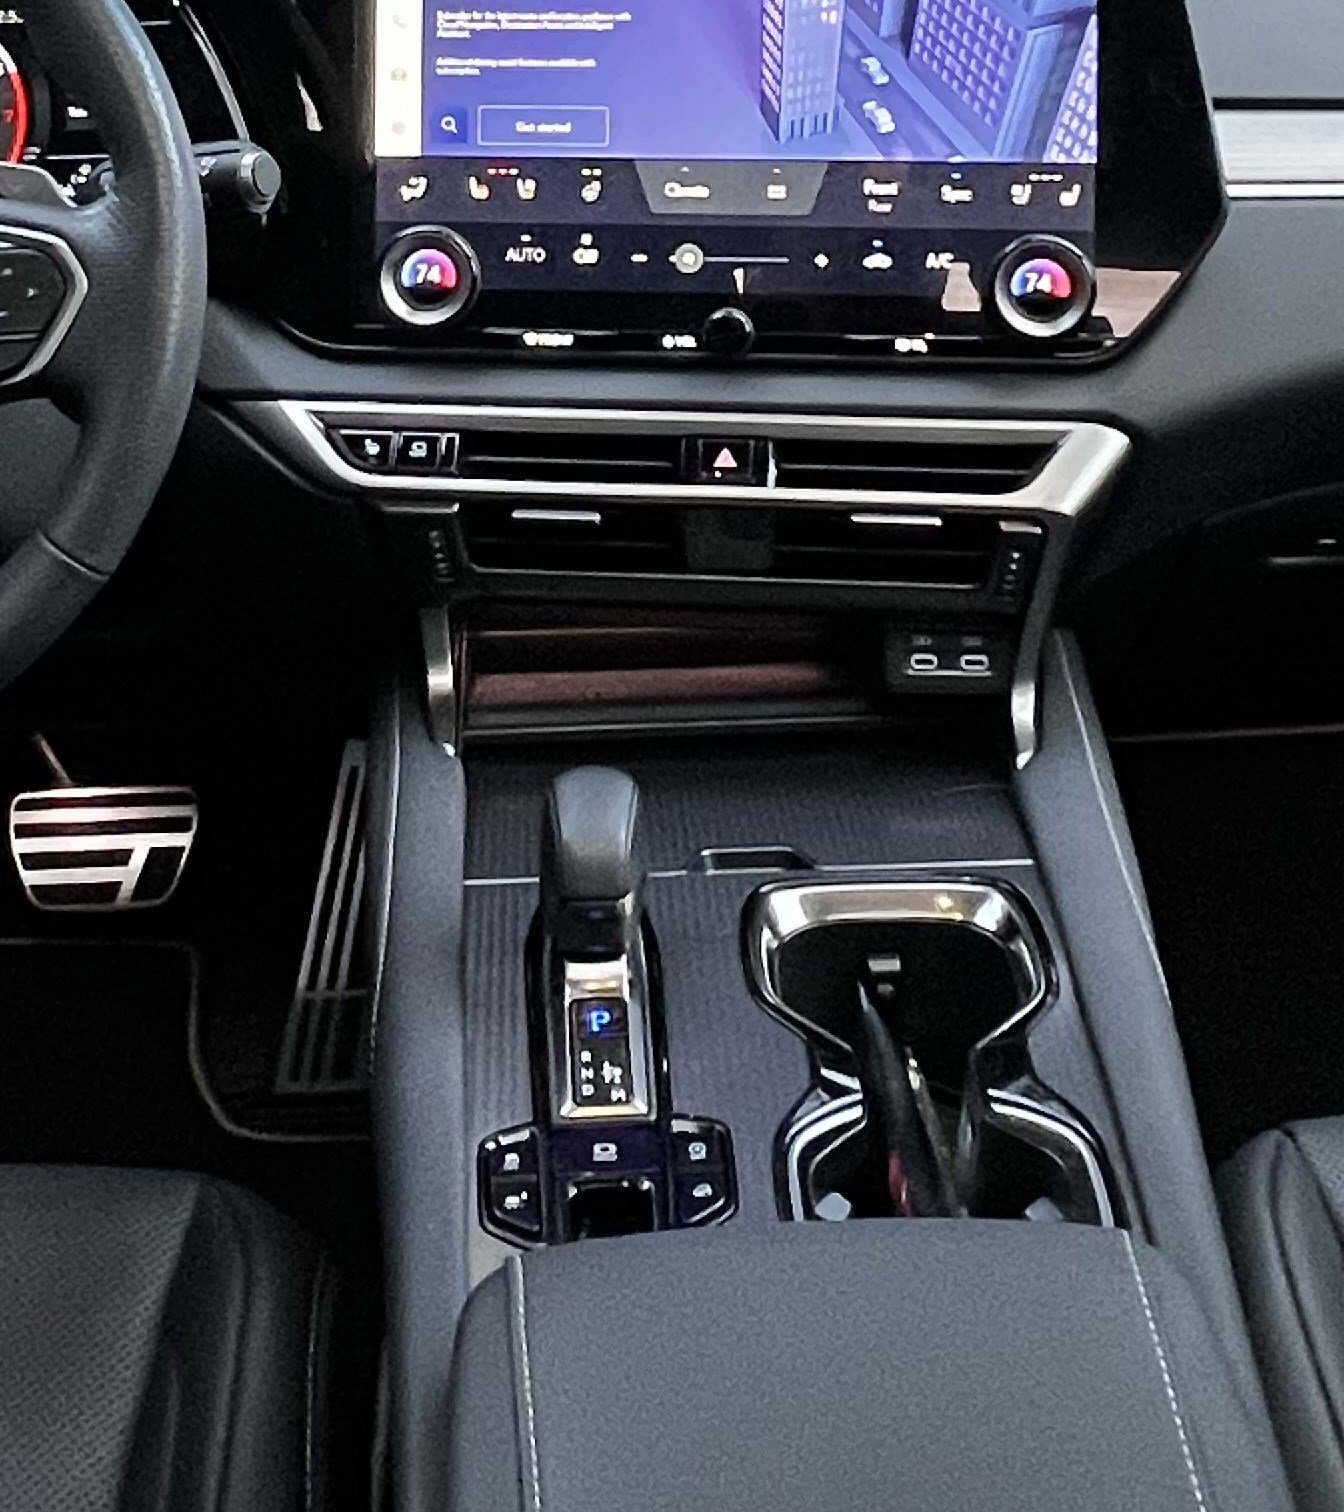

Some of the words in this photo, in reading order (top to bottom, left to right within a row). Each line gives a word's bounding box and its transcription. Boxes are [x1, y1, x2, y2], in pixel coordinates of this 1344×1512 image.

[505, 247, 546, 263] AUTO
[416, 264, 442, 285] 74
[1024, 272, 1053, 294] 74
[588, 1010, 611, 1032] P
[580, 1067, 594, 1081] N
[581, 1084, 595, 1096] D
